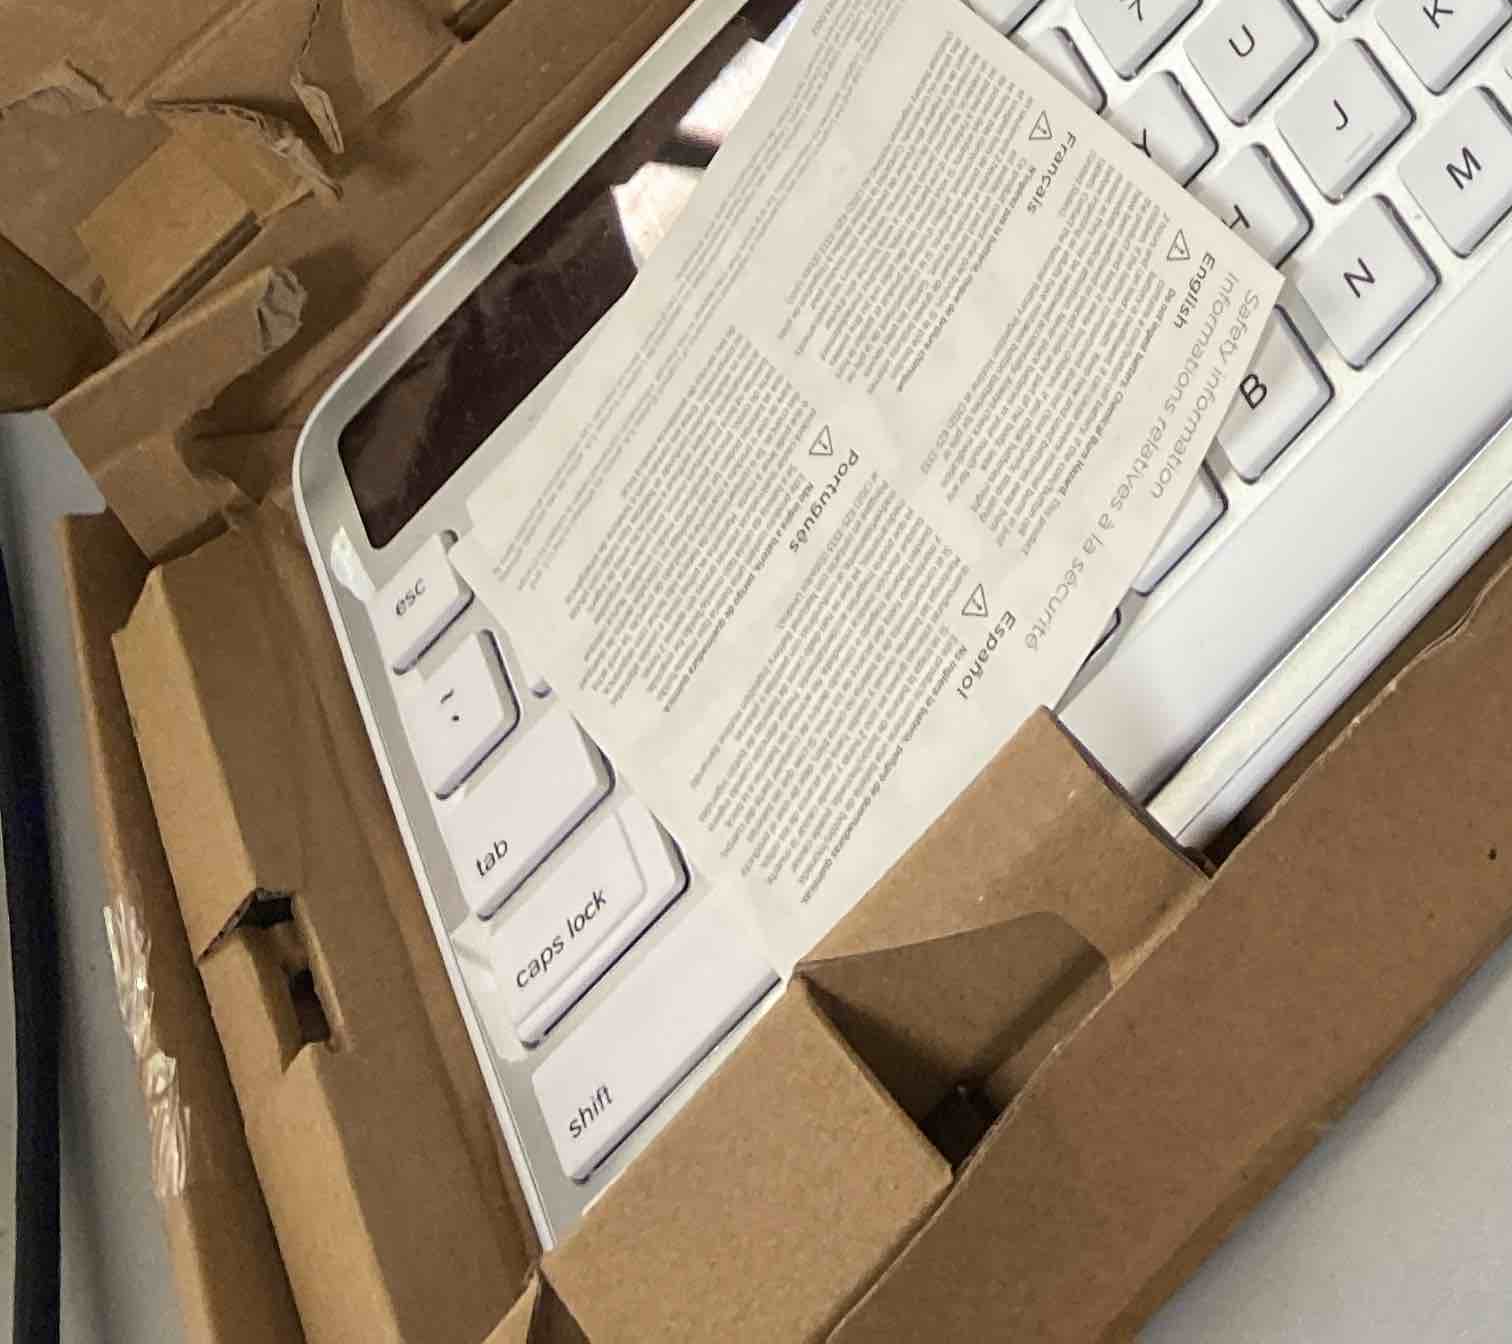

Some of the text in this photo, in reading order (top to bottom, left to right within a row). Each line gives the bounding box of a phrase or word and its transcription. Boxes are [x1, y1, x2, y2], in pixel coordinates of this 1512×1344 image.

[1227, 22, 1257, 59] U
[1332, 98, 1350, 132] J
[1130, 127, 1153, 160] Y
[1444, 145, 1483, 191] M
[1022, 130, 1079, 216] Français
[1166, 250, 1220, 330] English
[1342, 256, 1377, 300] N
[1154, 272, 1248, 413] Informations
[1143, 288, 1264, 501] Safety information
[1237, 372, 1269, 411] B
[1106, 414, 1173, 513] relatives
[786, 442, 861, 559] Português
[1079, 531, 1105, 558] la
[394, 577, 426, 618] esc
[1021, 556, 1088, 654] sécurité
[953, 606, 1018, 704] Español
[475, 838, 509, 878] tab
[515, 889, 608, 989] caps lock
[568, 1085, 613, 1140] shift
